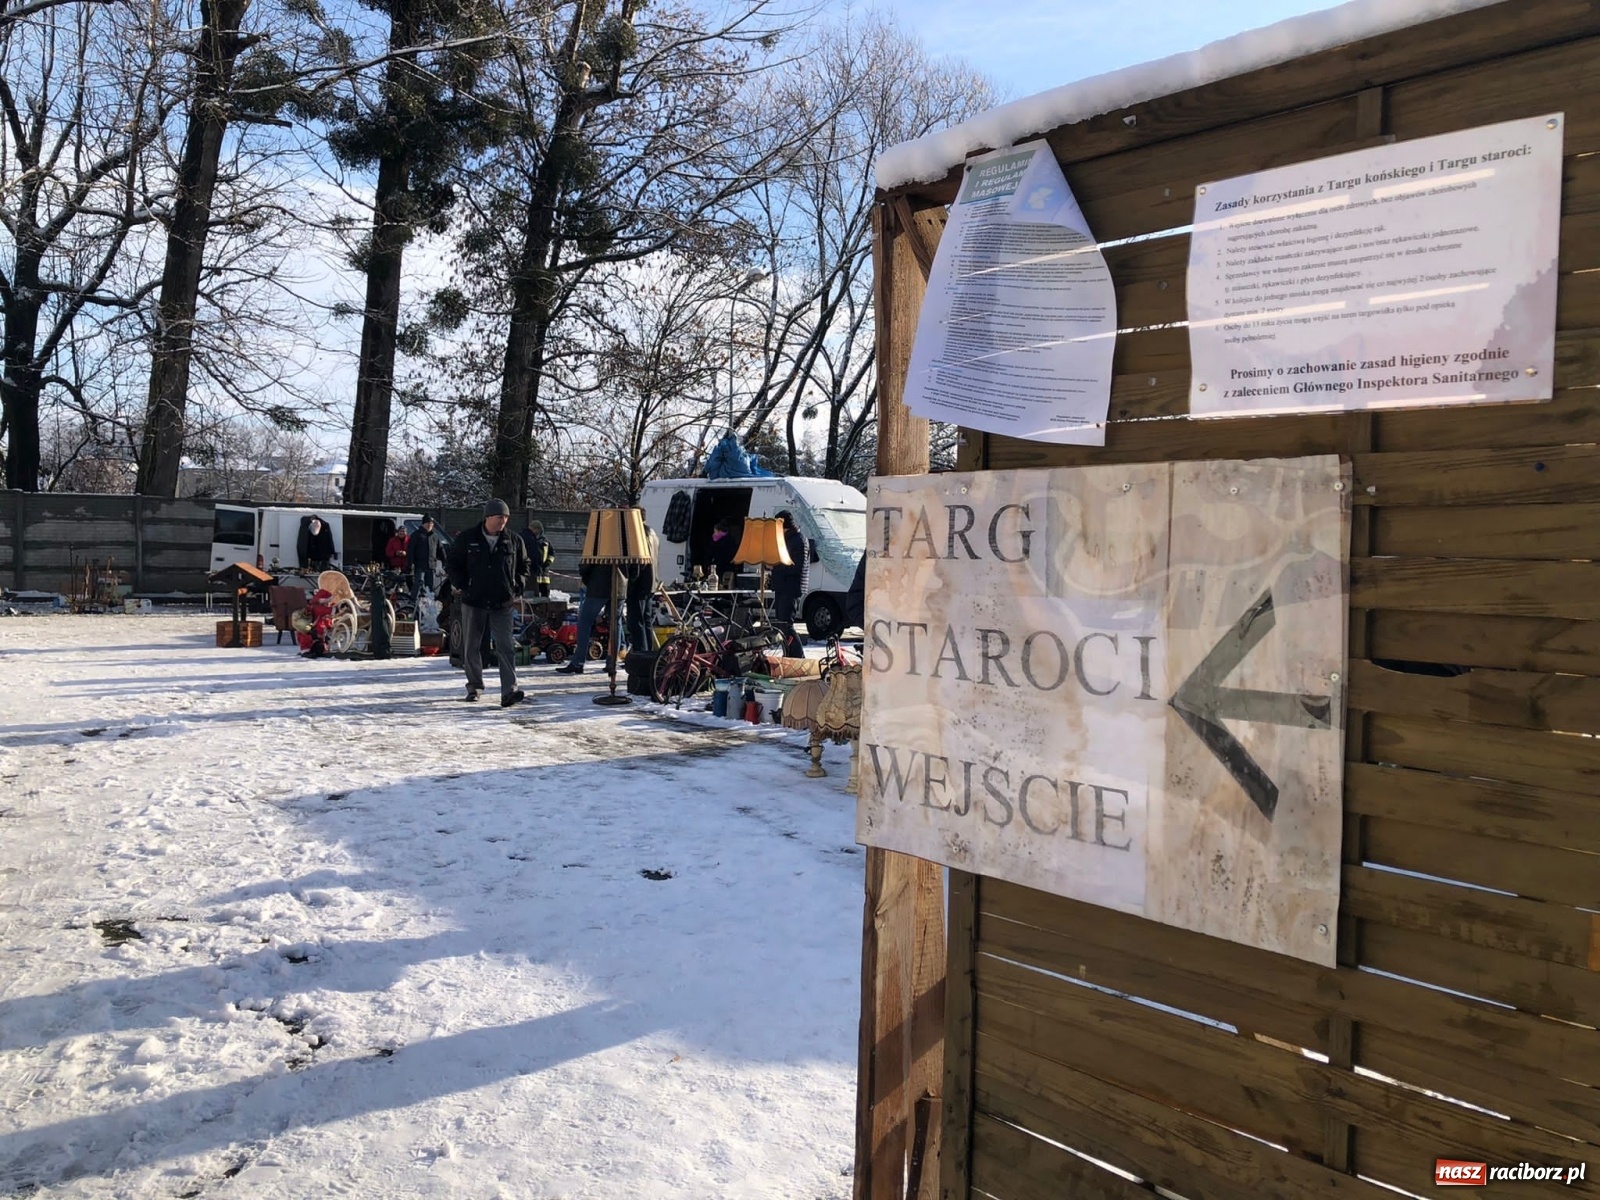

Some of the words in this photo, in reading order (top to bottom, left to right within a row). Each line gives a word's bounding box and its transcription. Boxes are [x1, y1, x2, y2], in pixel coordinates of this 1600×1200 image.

[971, 181, 1018, 198] MASOWEJ
[1215, 198, 1250, 211] Zasady
[1253, 186, 1315, 204] korzystania
[1318, 185, 1324, 193] z
[1327, 176, 1361, 191] Targu
[1365, 166, 1426, 183] końskiego
[1430, 161, 1434, 172] i
[1438, 156, 1477, 170] Targu
[1481, 144, 1532, 163] staroci:
[1223, 390, 1229, 398] z
[1232, 385, 1290, 397] zaleceniem
[1293, 381, 1354, 394] Głównego
[1357, 376, 1428, 391] Inspektora
[1432, 369, 1519, 384] Sanitarnego
[1230, 367, 1274, 379] Prosimy
[1277, 367, 1284, 375] o
[1287, 360, 1357, 375] zachowanie
[1360, 356, 1396, 369] zasad
[1400, 353, 1450, 368] higieny
[1453, 348, 1510, 364] zgodnie
[872, 503, 1036, 563] TARG
[870, 619, 1158, 702] STAROCI
[866, 743, 1133, 852] WEJŚCIE
